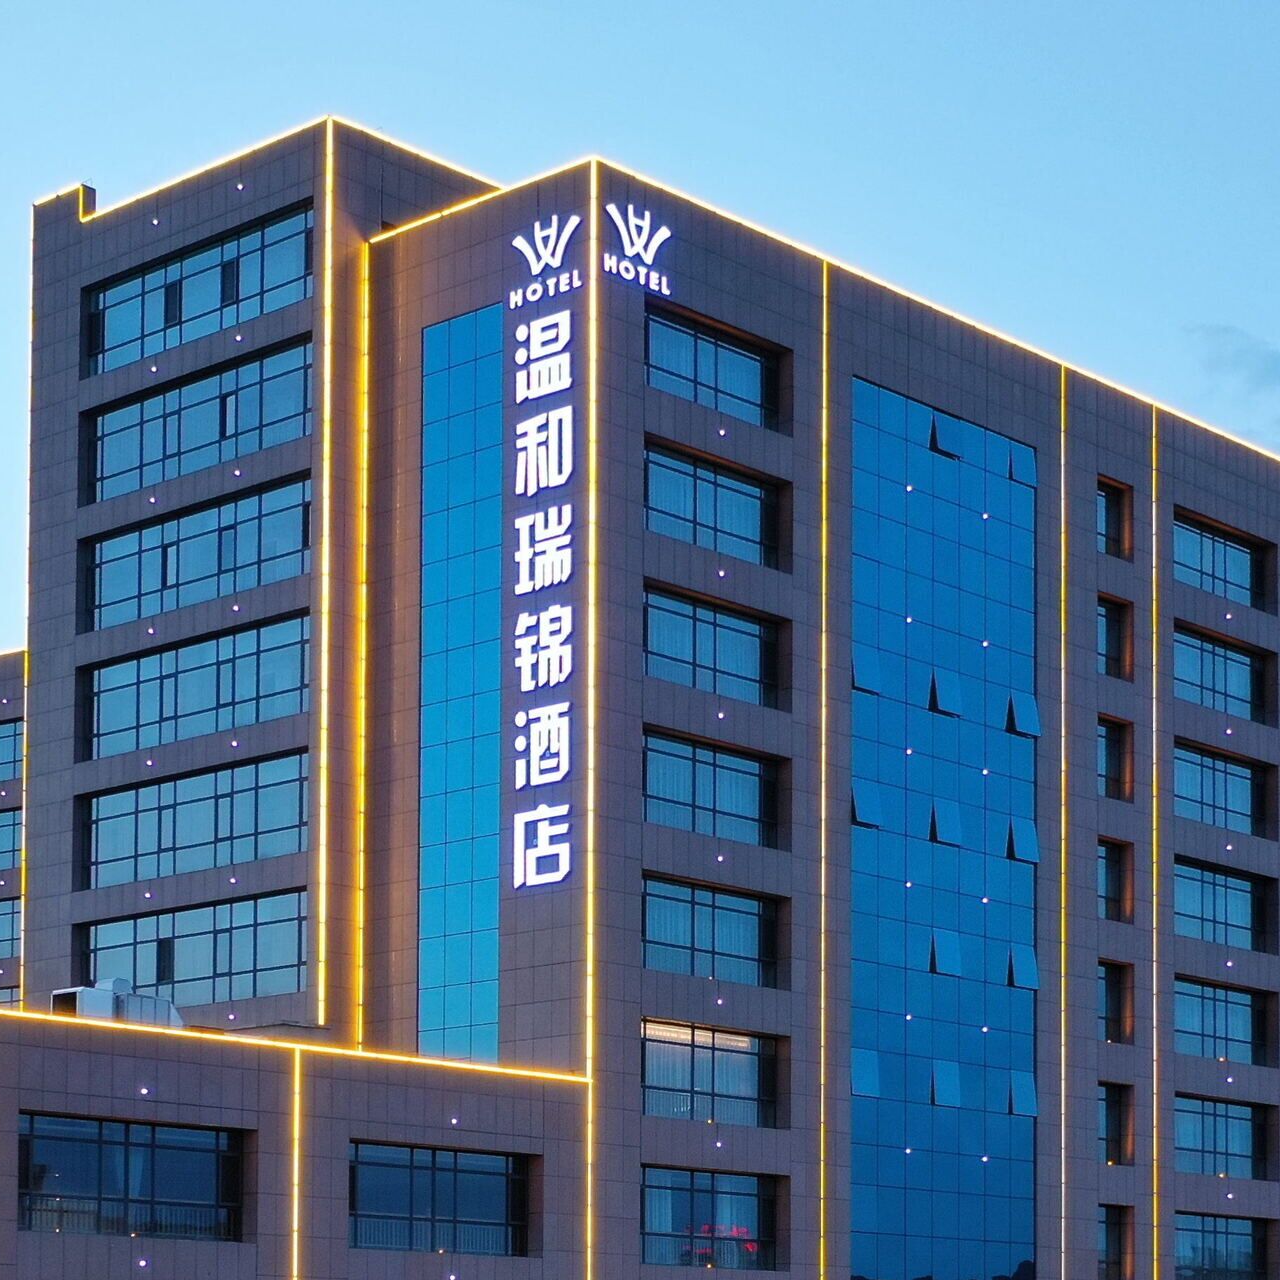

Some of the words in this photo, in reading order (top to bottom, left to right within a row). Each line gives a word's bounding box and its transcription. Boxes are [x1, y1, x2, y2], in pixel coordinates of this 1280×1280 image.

[509, 269, 582, 310] HOTEL
[603, 253, 671, 296] HOTEL
[513, 309, 573, 890] 温和瑞锦酒店
